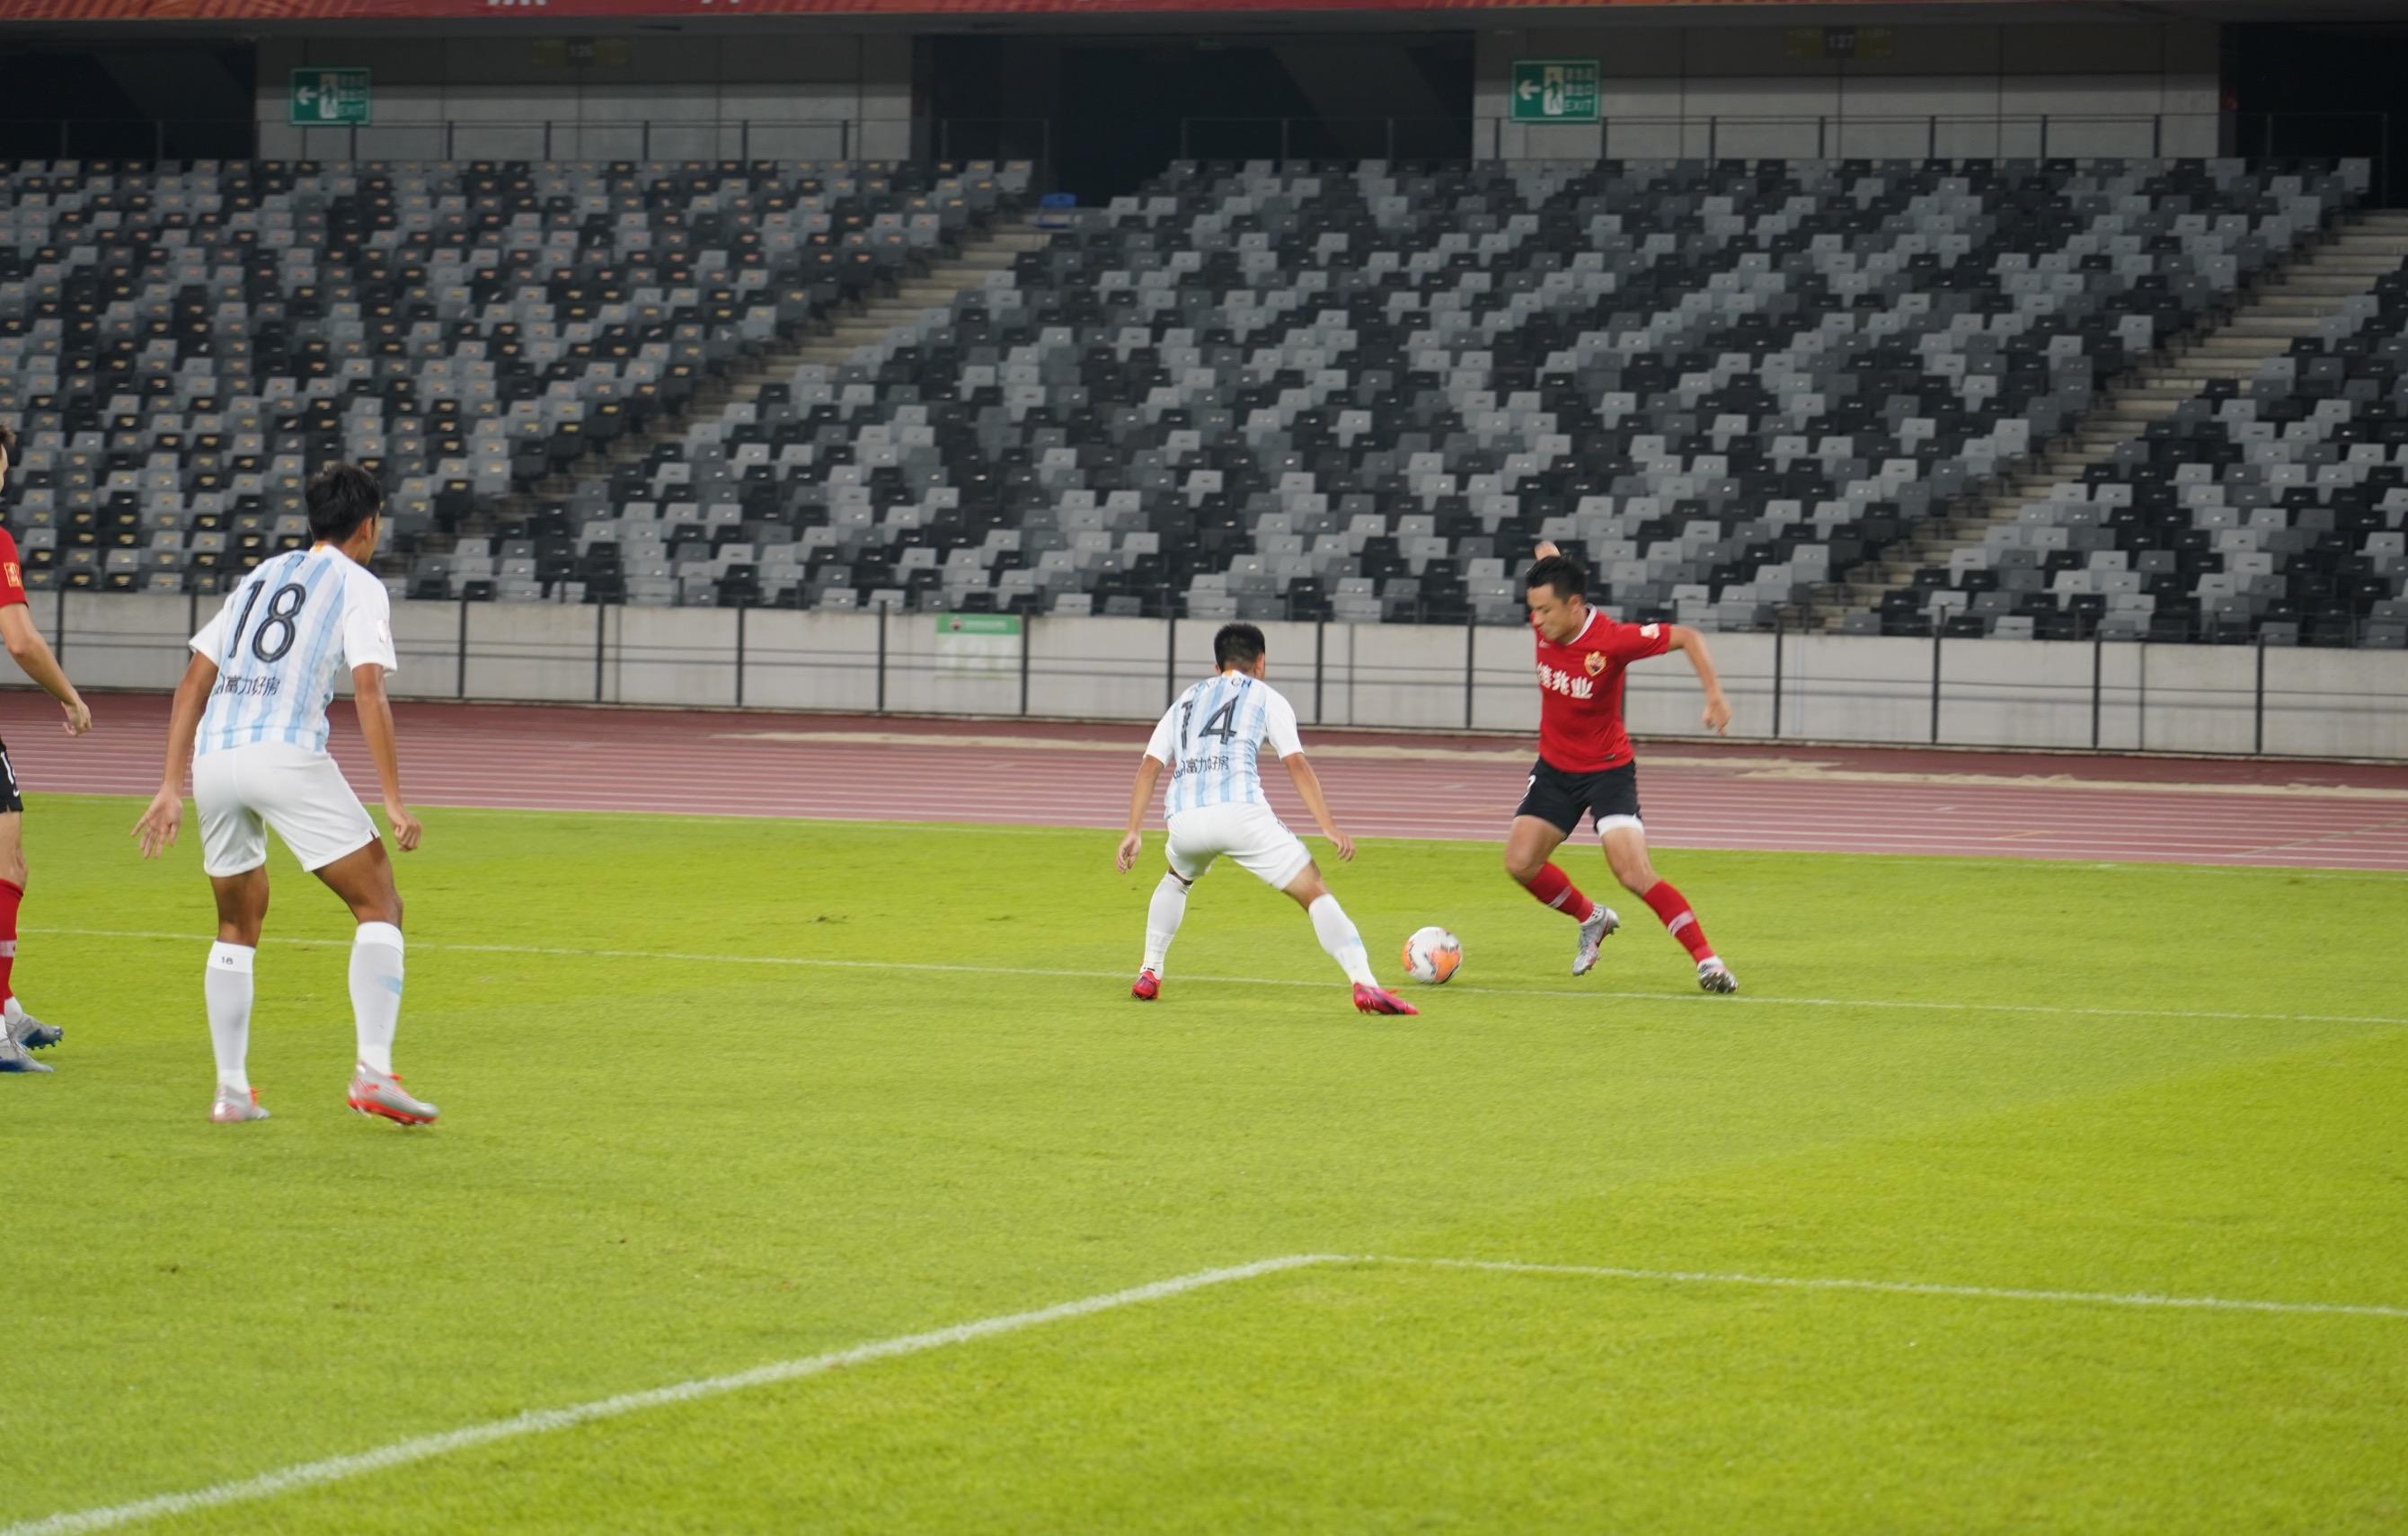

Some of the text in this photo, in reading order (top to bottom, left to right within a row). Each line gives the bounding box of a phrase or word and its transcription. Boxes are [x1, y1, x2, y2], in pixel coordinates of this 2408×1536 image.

[1565, 100, 1593, 111] EXIT
[228, 580, 306, 664] 18
[1181, 694, 1239, 751] 14
[221, 956, 234, 965] 18
